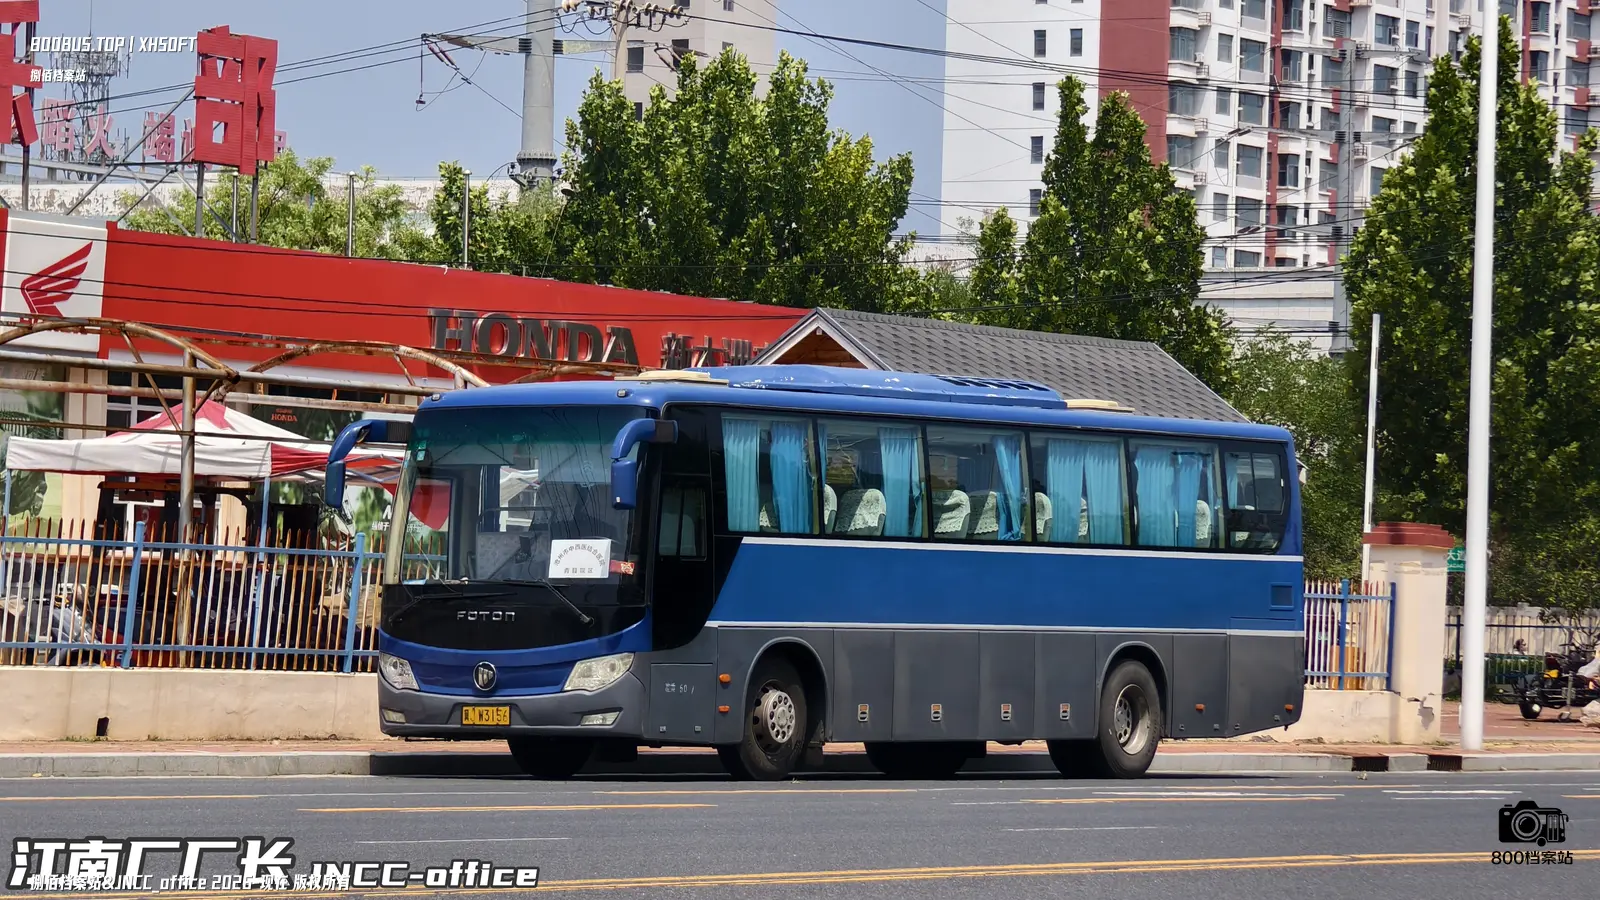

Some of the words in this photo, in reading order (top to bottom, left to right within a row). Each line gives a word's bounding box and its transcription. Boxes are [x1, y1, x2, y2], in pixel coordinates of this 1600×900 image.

[428, 308, 640, 365] HONDA
[271, 413, 298, 422] HONDA
[457, 610, 516, 621] FOTON
